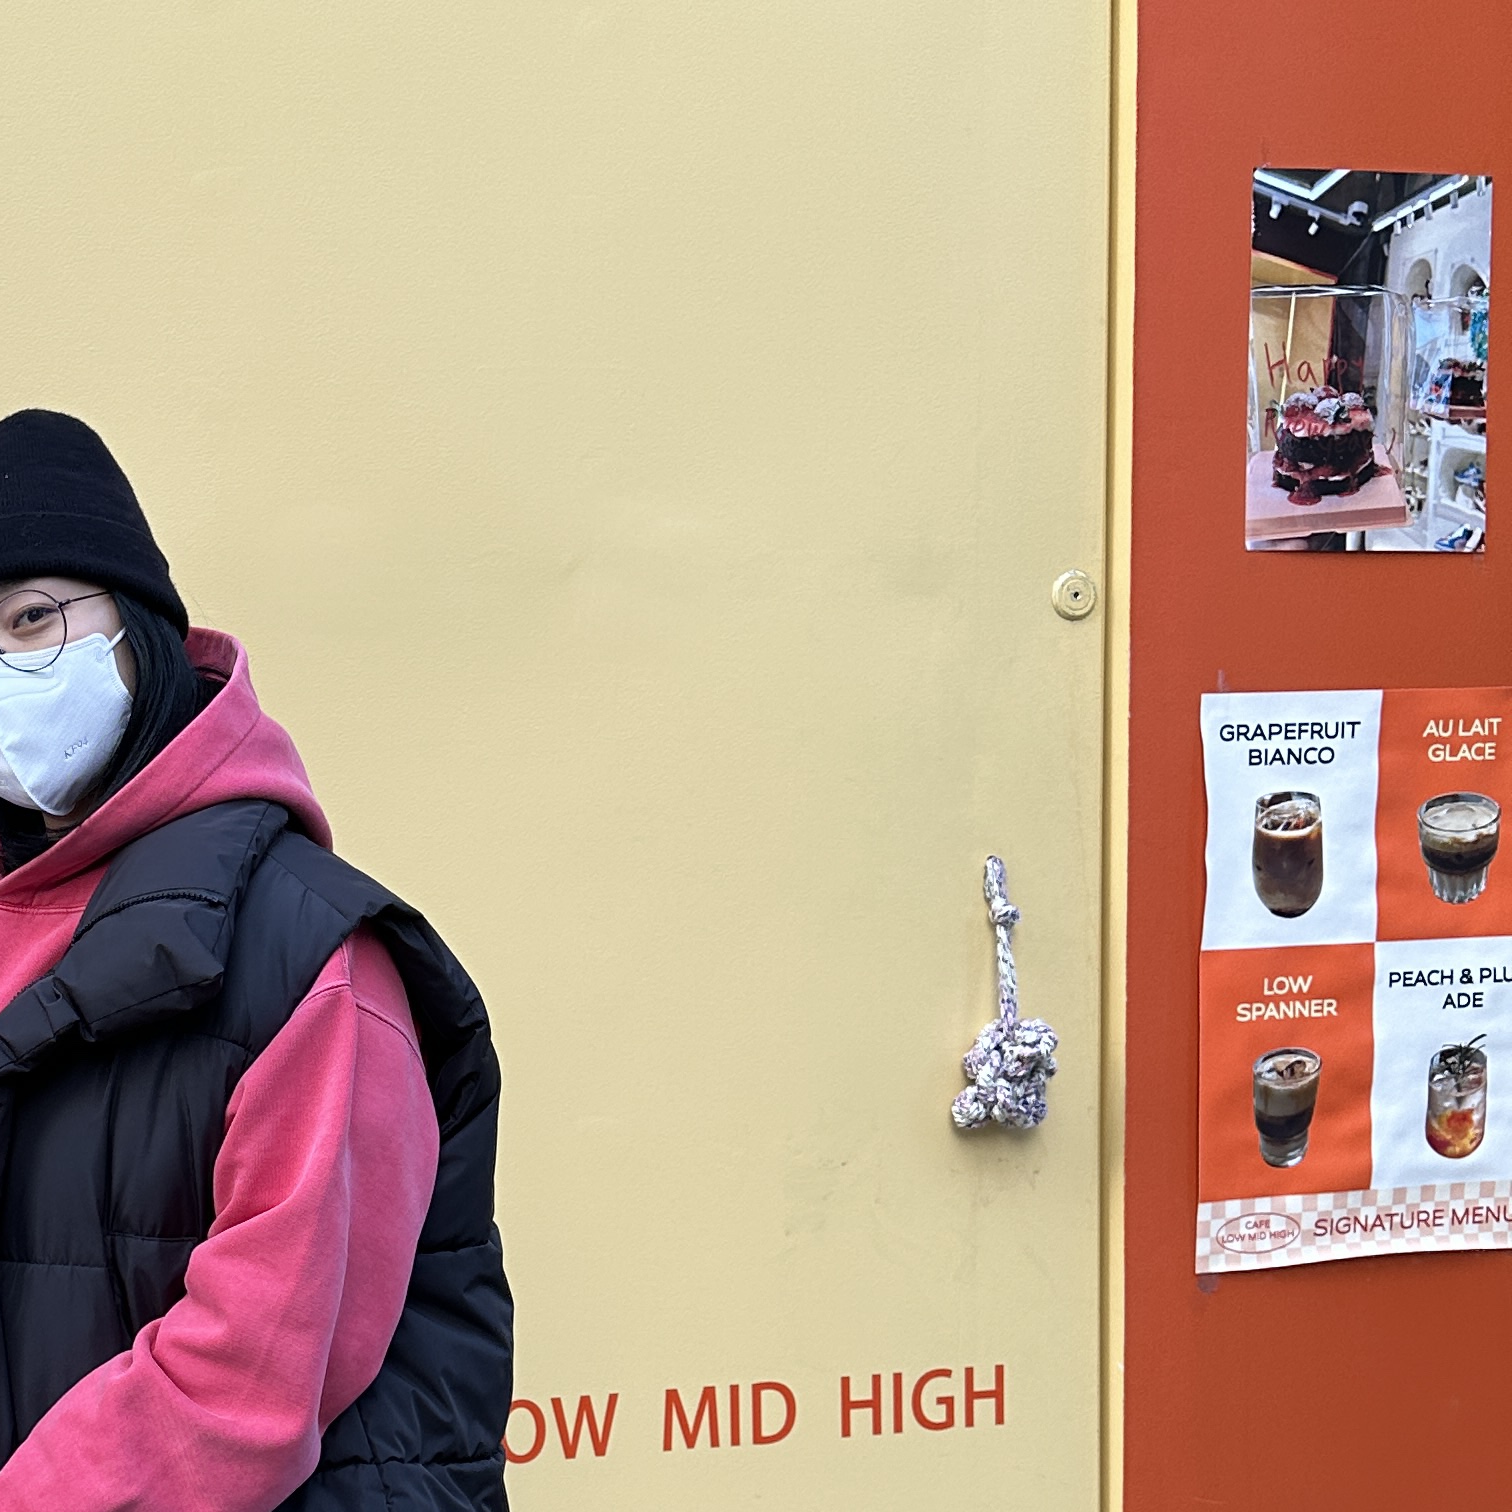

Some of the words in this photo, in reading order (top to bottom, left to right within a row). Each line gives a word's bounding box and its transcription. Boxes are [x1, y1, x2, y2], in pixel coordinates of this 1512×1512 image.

[1219, 721, 1361, 742] GRAPEFRUIT
[1423, 719, 1454, 738] AU
[1457, 717, 1502, 736] LAIT
[1248, 746, 1335, 766] BIANCO
[1427, 742, 1497, 762] GLACE
[1263, 975, 1313, 995] LOW
[1388, 969, 1454, 988] PEACH
[1459, 967, 1474, 984] &
[1236, 998, 1338, 1022] SPANNER
[1442, 992, 1484, 1009] ADE
[1313, 1209, 1445, 1237] SIGNATURE
[1221, 1233, 1246, 1244] LOW
[501, 1393, 619, 1465] OW
[662, 1381, 797, 1452] MID
[840, 1364, 1005, 1438] HIGH
